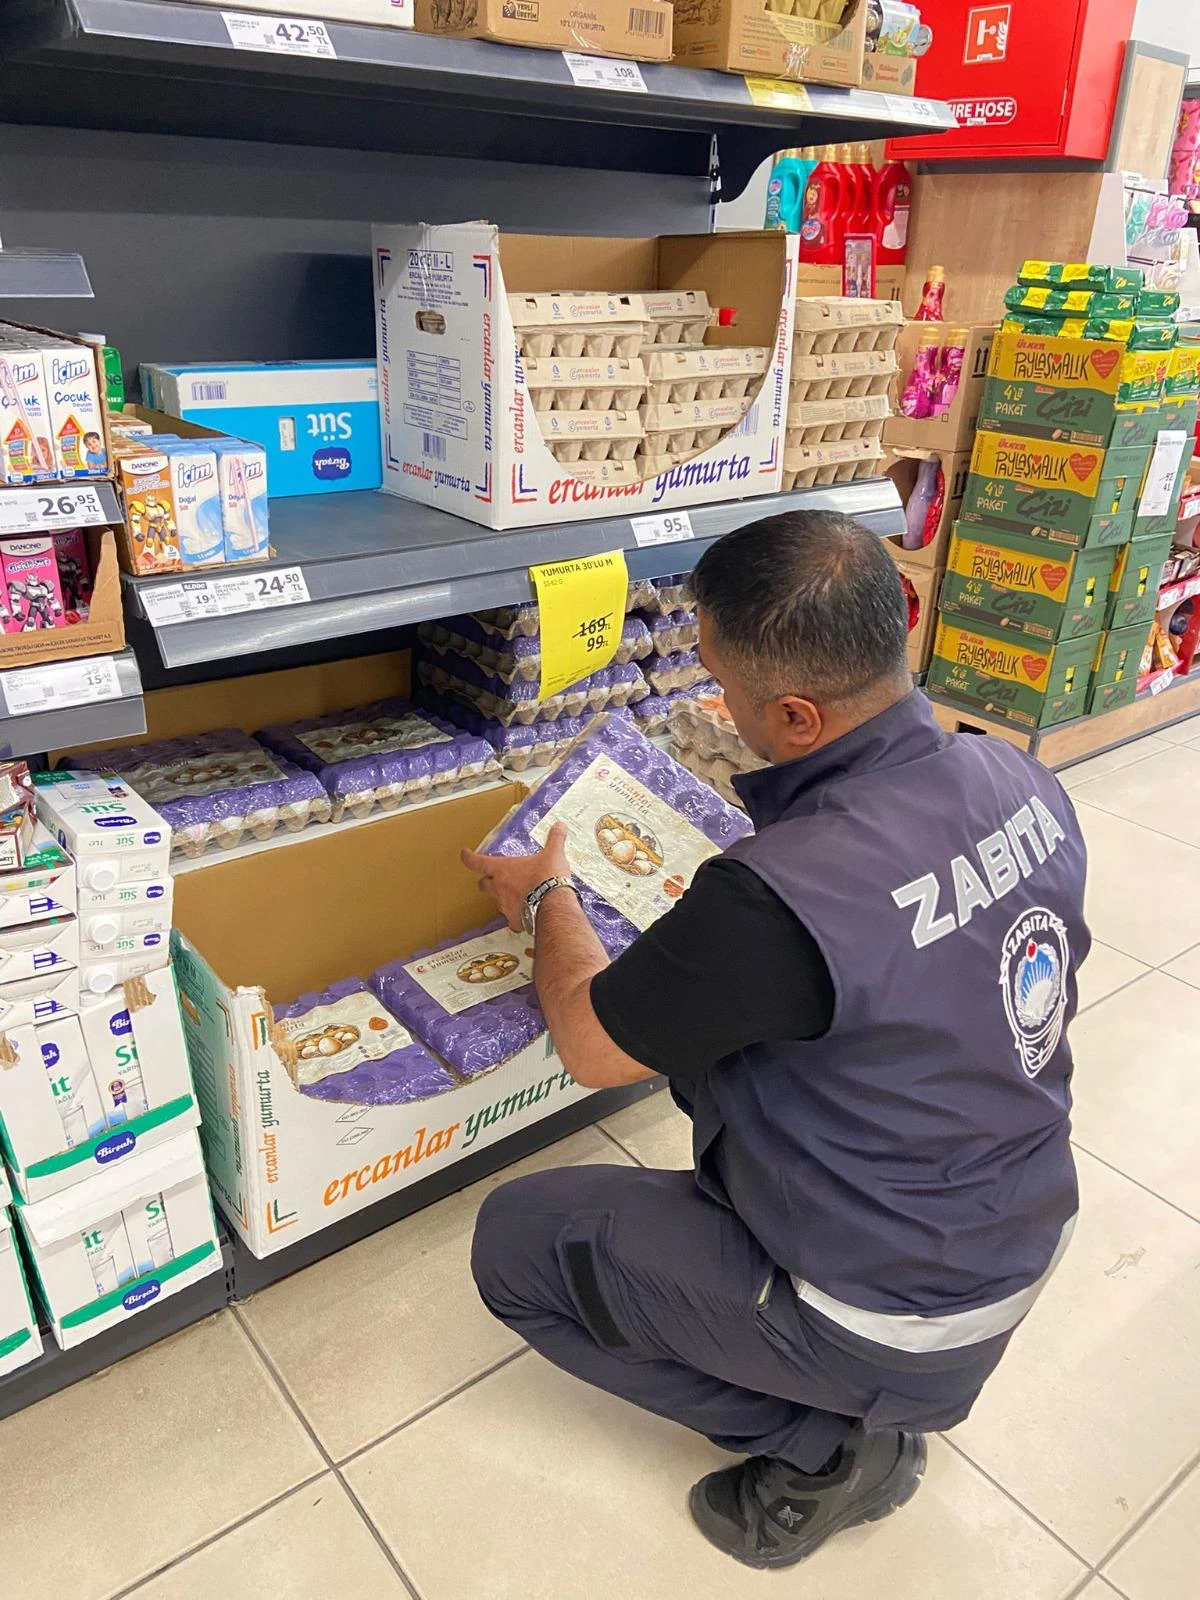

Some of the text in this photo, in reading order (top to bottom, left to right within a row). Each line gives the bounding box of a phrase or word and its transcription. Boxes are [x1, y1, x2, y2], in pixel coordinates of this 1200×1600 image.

[614, 67, 635, 78] 108
[949, 103, 973, 119] IRE
[975, 101, 1014, 118] HOSE
[482, 313, 495, 382] ercanlar
[776, 308, 789, 367] ercanlar
[52, 358, 89, 385] İçim
[54, 391, 92, 405] Çocuk
[772, 367, 785, 428] yumurta
[306, 411, 353, 442] Süt
[480, 382, 494, 452] yumurta
[508, 388, 525, 454] ercanlar
[177, 462, 212, 488] İçim
[402, 460, 471, 493] ercanlar yumurta
[651, 453, 751, 503] yumurta
[663, 517, 683, 533] 95
[540, 564, 582, 578] YUMURTA
[605, 558, 614, 567] M
[579, 616, 606, 638] 169
[586, 634, 604, 653] 99
[890, 794, 1067, 949] ZABITA
[1007, 914, 1049, 956] ZABITA
[255, 1069, 280, 1128] yumurta
[258, 1132, 279, 1184] ercanlar
[322, 1121, 461, 1207] ercanlar
